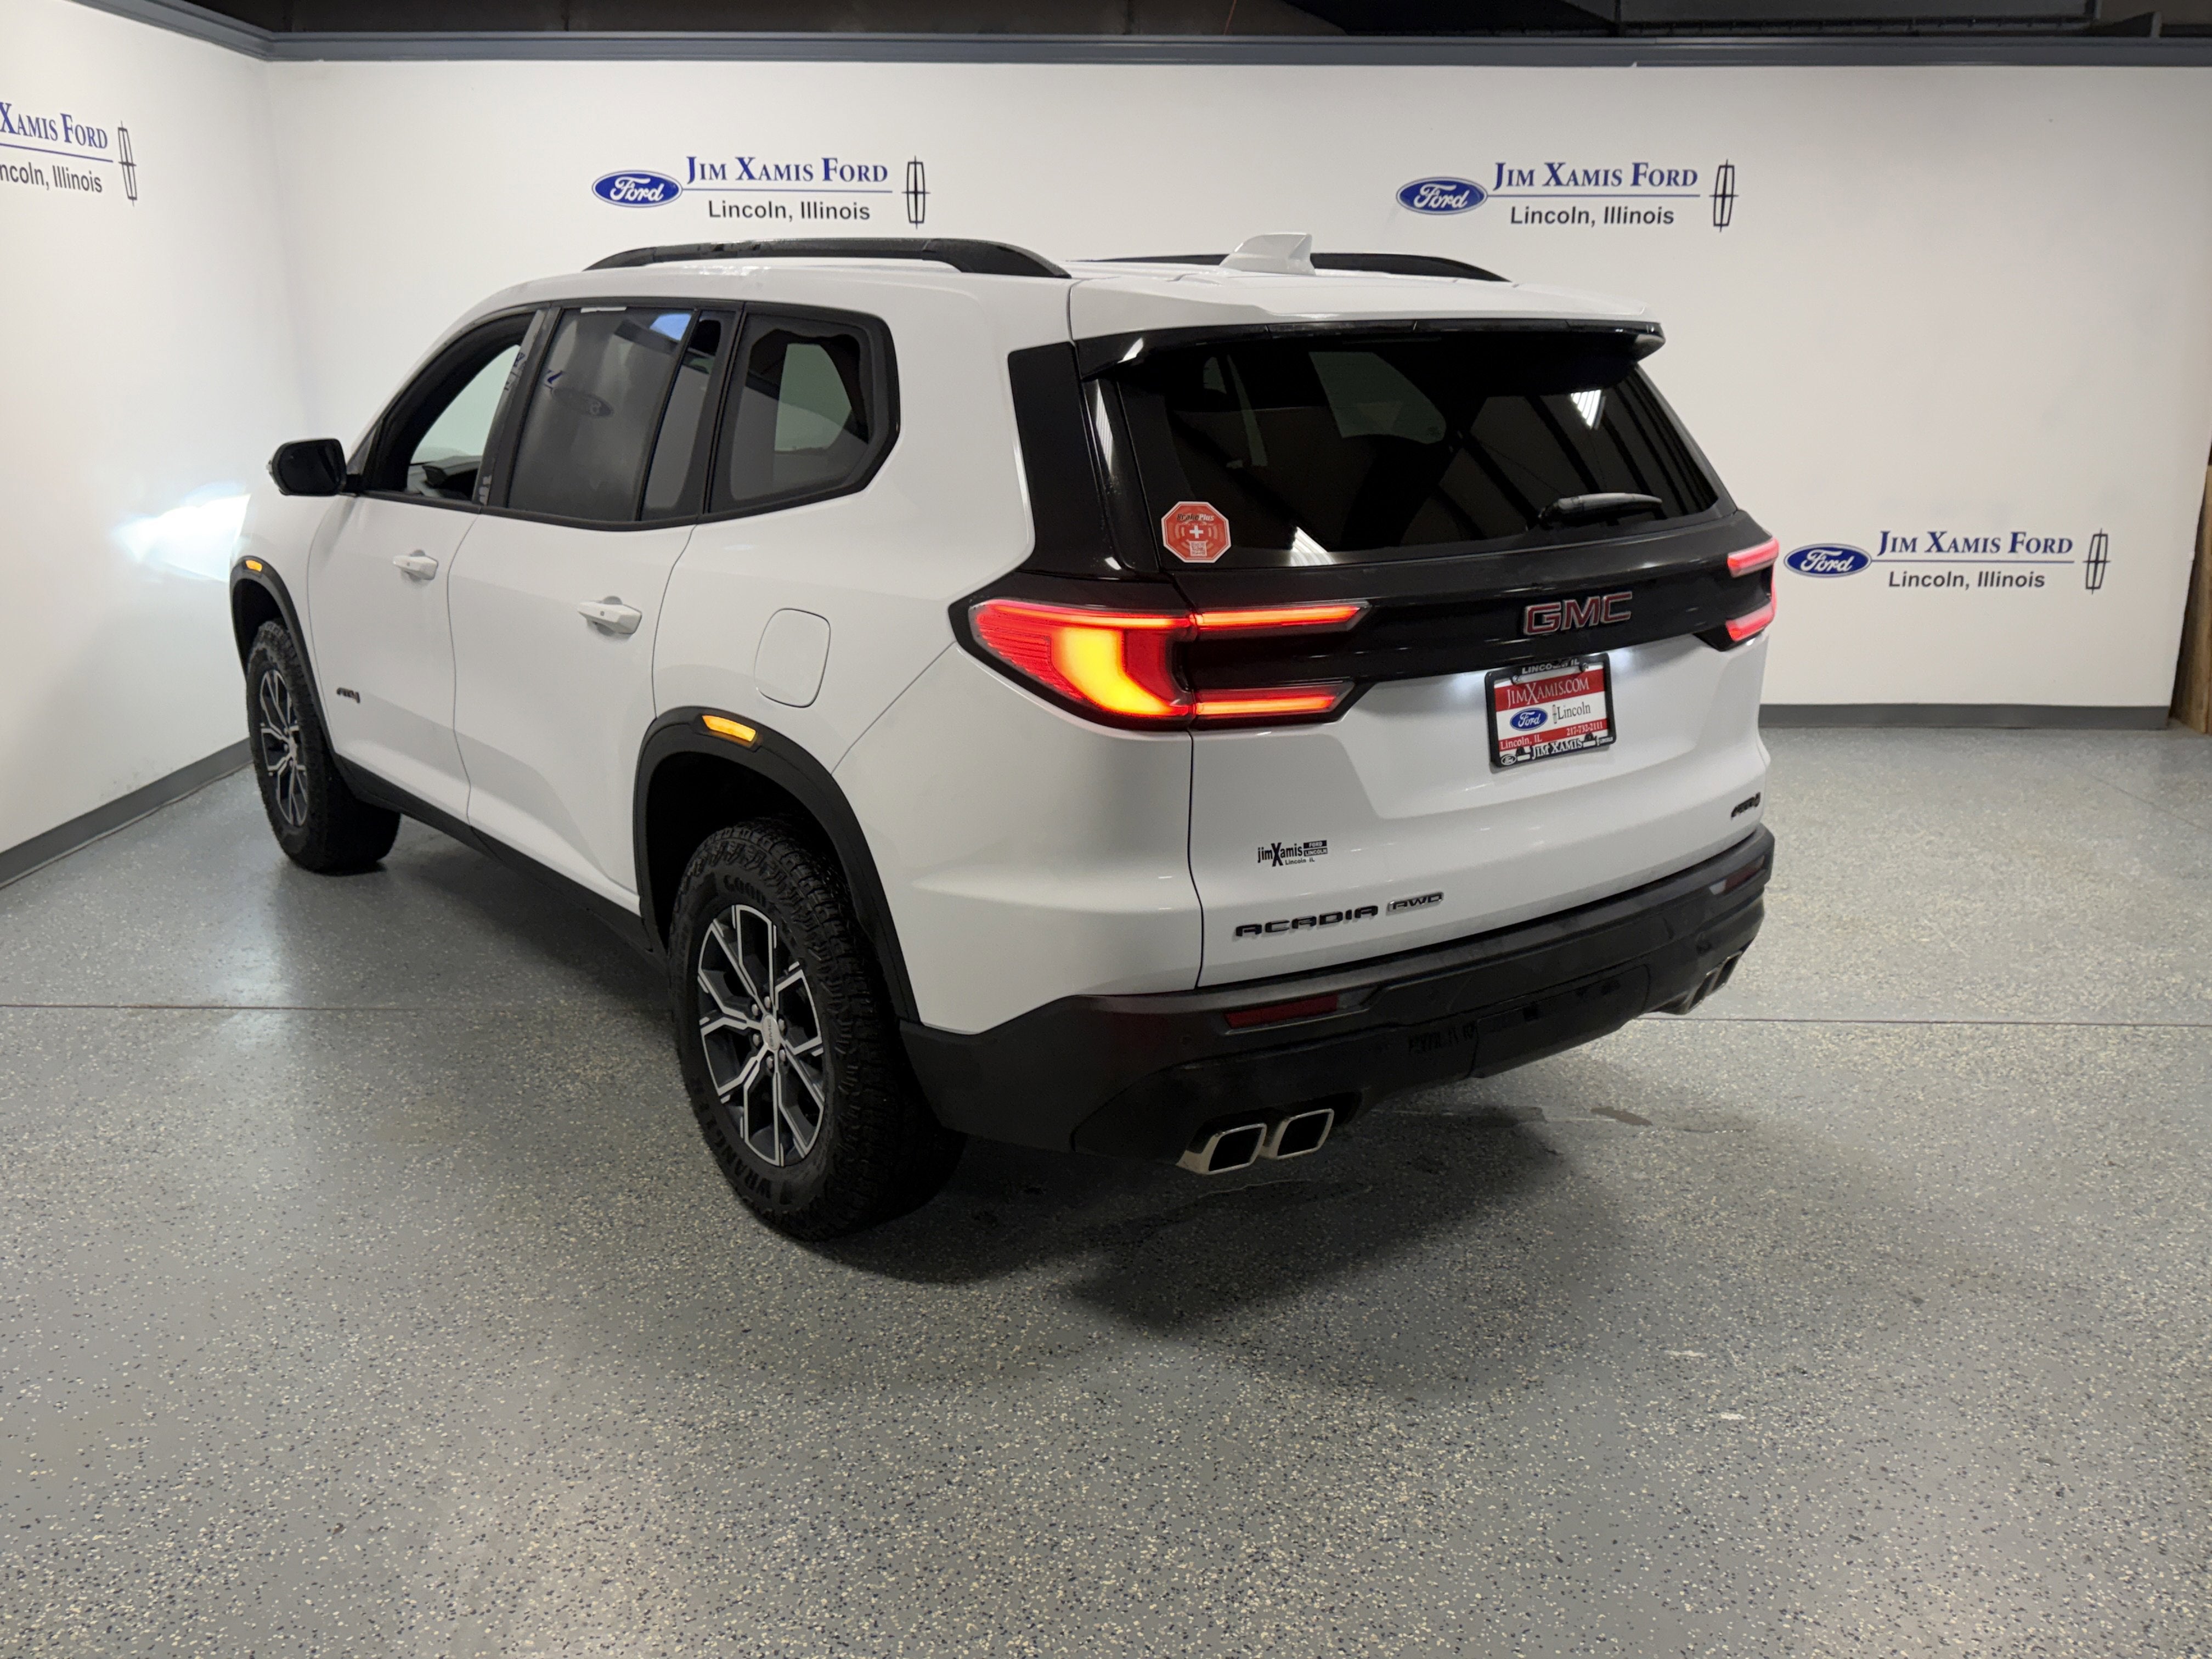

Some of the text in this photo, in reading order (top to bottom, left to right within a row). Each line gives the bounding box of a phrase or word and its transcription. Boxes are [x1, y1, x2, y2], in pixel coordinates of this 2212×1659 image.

[0, 101, 108, 149] XAMIS FORD
[0, 161, 103, 193] ncoln, Illinois
[686, 156, 889, 185] JIM XAMIS FORD
[1493, 162, 1697, 191] JIM XAMIS FORD
[610, 176, 664, 202] Ford
[1413, 184, 1469, 210] Ford
[708, 200, 870, 222] Lincoln, Illinois
[1510, 206, 1674, 228] Lincoln, Illinois
[1877, 531, 2073, 556] JIM XAMIS FORD
[1799, 550, 1854, 573] Ford
[1889, 571, 2045, 590] Lincoln, Illinois
[1523, 591, 1633, 636] GMC
[1507, 678, 1590, 708] JIMXAMIS.COM
[1518, 711, 1541, 727] Ford
[1557, 702, 1591, 720] Lincoln
[1566, 721, 1603, 736] 217-732-2111
[1500, 734, 1543, 749] Lincoln, IL
[1532, 745, 1550, 760] JIM
[1551, 739, 1583, 754] XAMIS
[1257, 842, 1303, 867] jimXamis
[1305, 848, 1327, 856] LINCOLN
[1392, 893, 1443, 910] AWD
[1235, 905, 1379, 937] ACADIA
